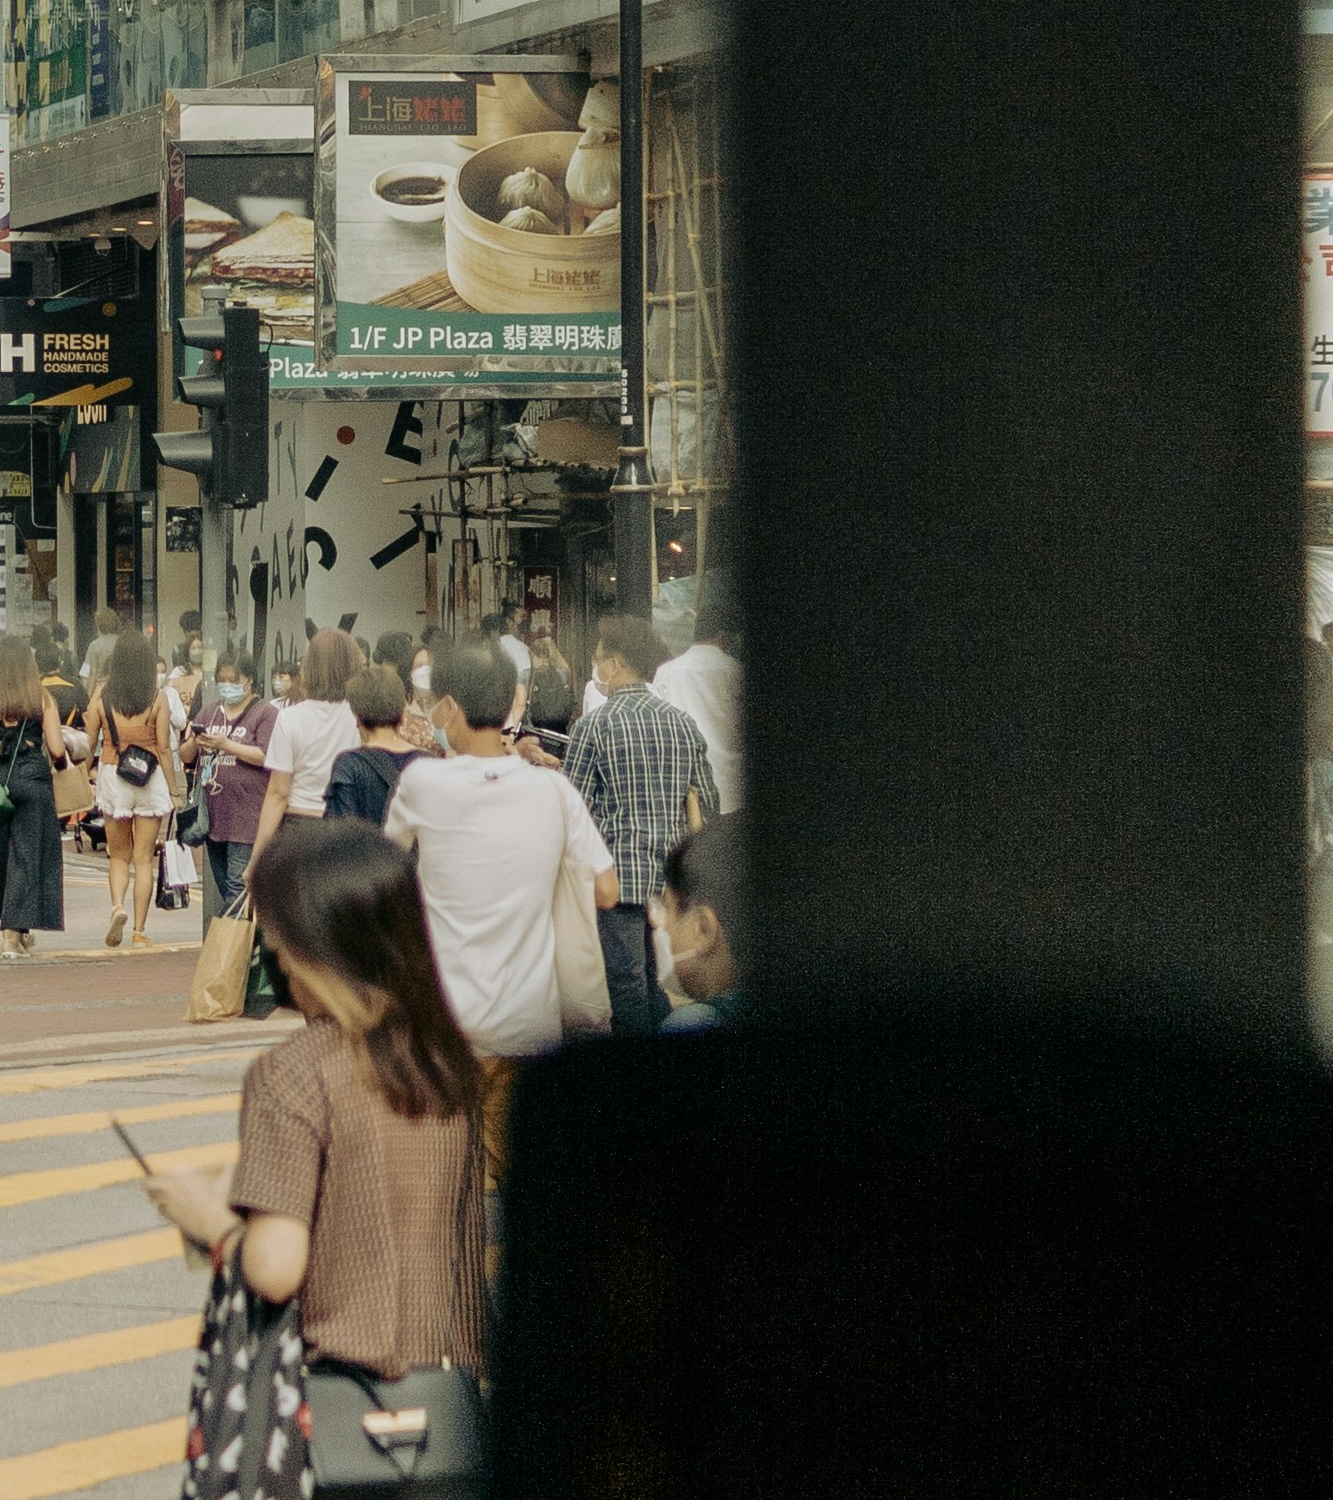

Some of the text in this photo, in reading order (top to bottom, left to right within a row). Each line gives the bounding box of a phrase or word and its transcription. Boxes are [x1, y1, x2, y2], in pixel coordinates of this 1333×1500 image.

[43, 333, 110, 350] FRESH
[349, 326, 387, 349] 1/F
[393, 326, 422, 350] JP
[430, 326, 493, 350] Plaza
[43, 351, 109, 362] HANDMADE
[43, 363, 109, 374] COSMETICS
